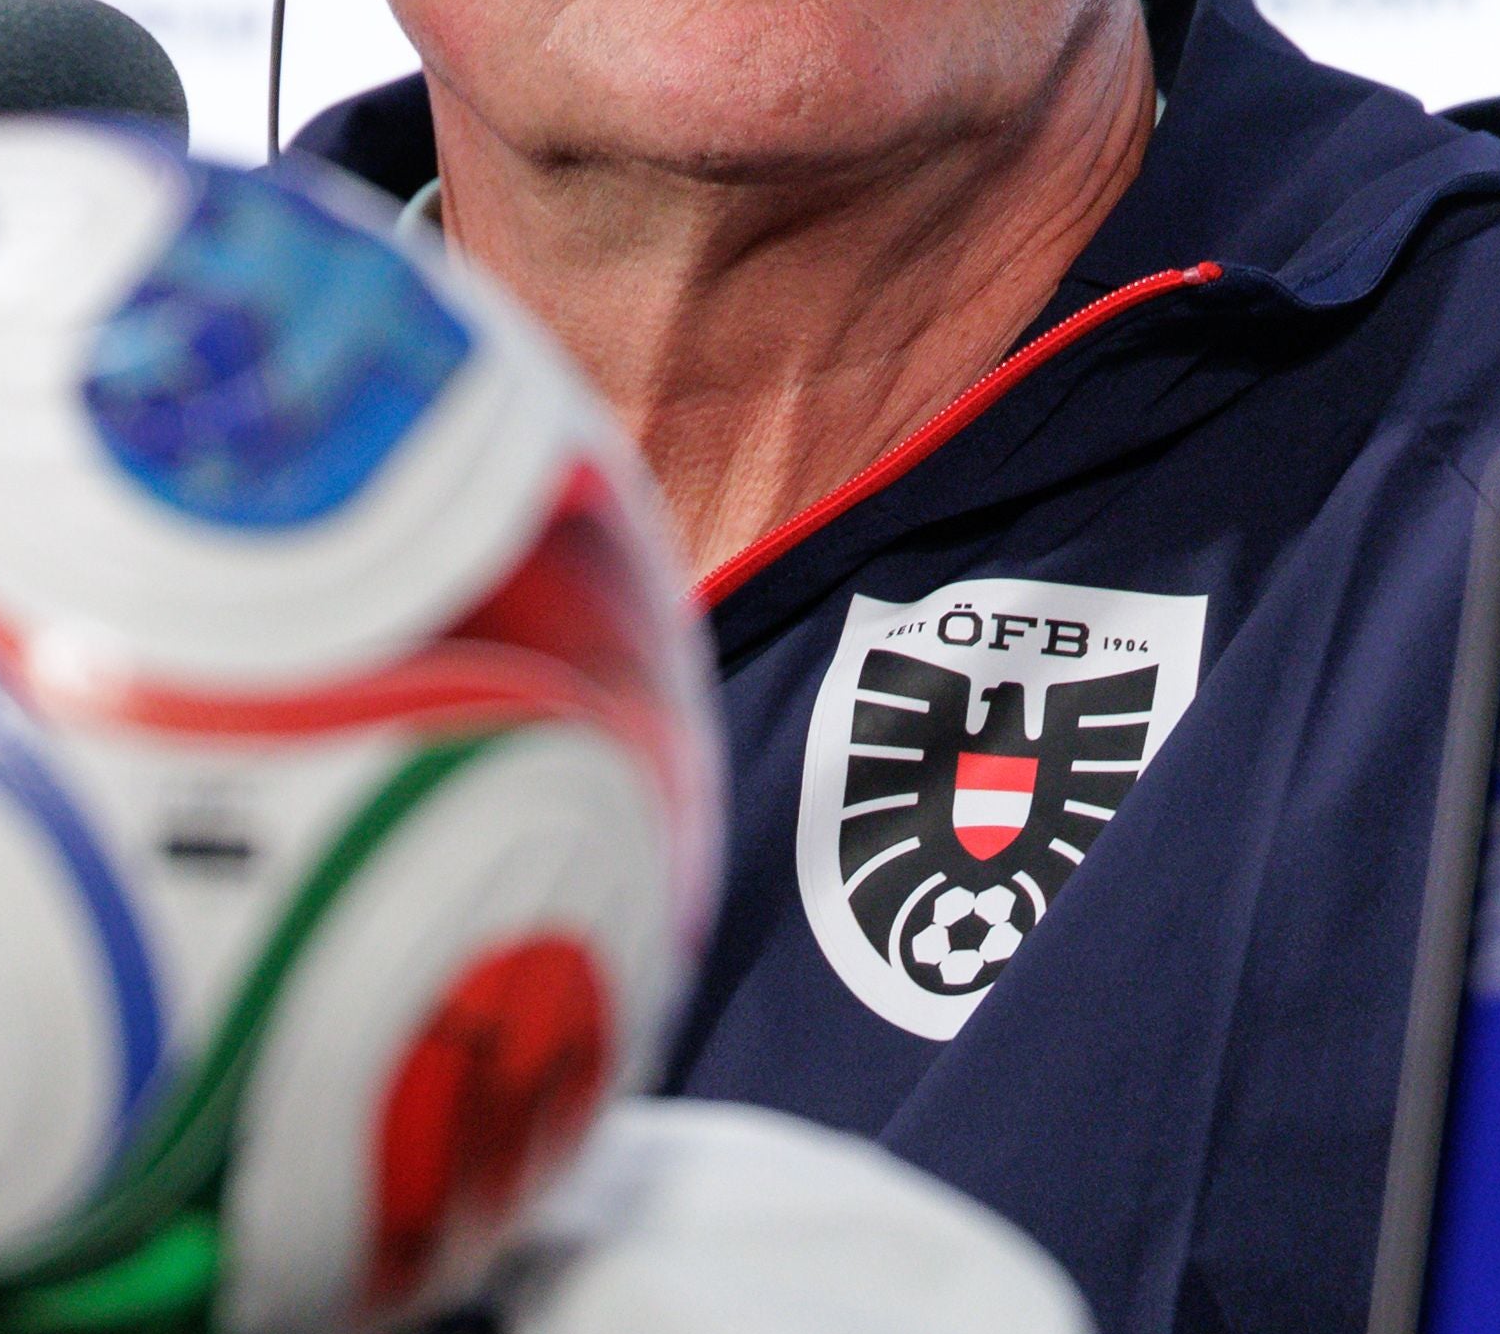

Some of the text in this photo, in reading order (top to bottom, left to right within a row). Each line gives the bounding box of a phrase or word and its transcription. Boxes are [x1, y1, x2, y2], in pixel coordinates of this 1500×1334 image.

[885, 602, 1150, 659] SEIT ÖFB 1904
